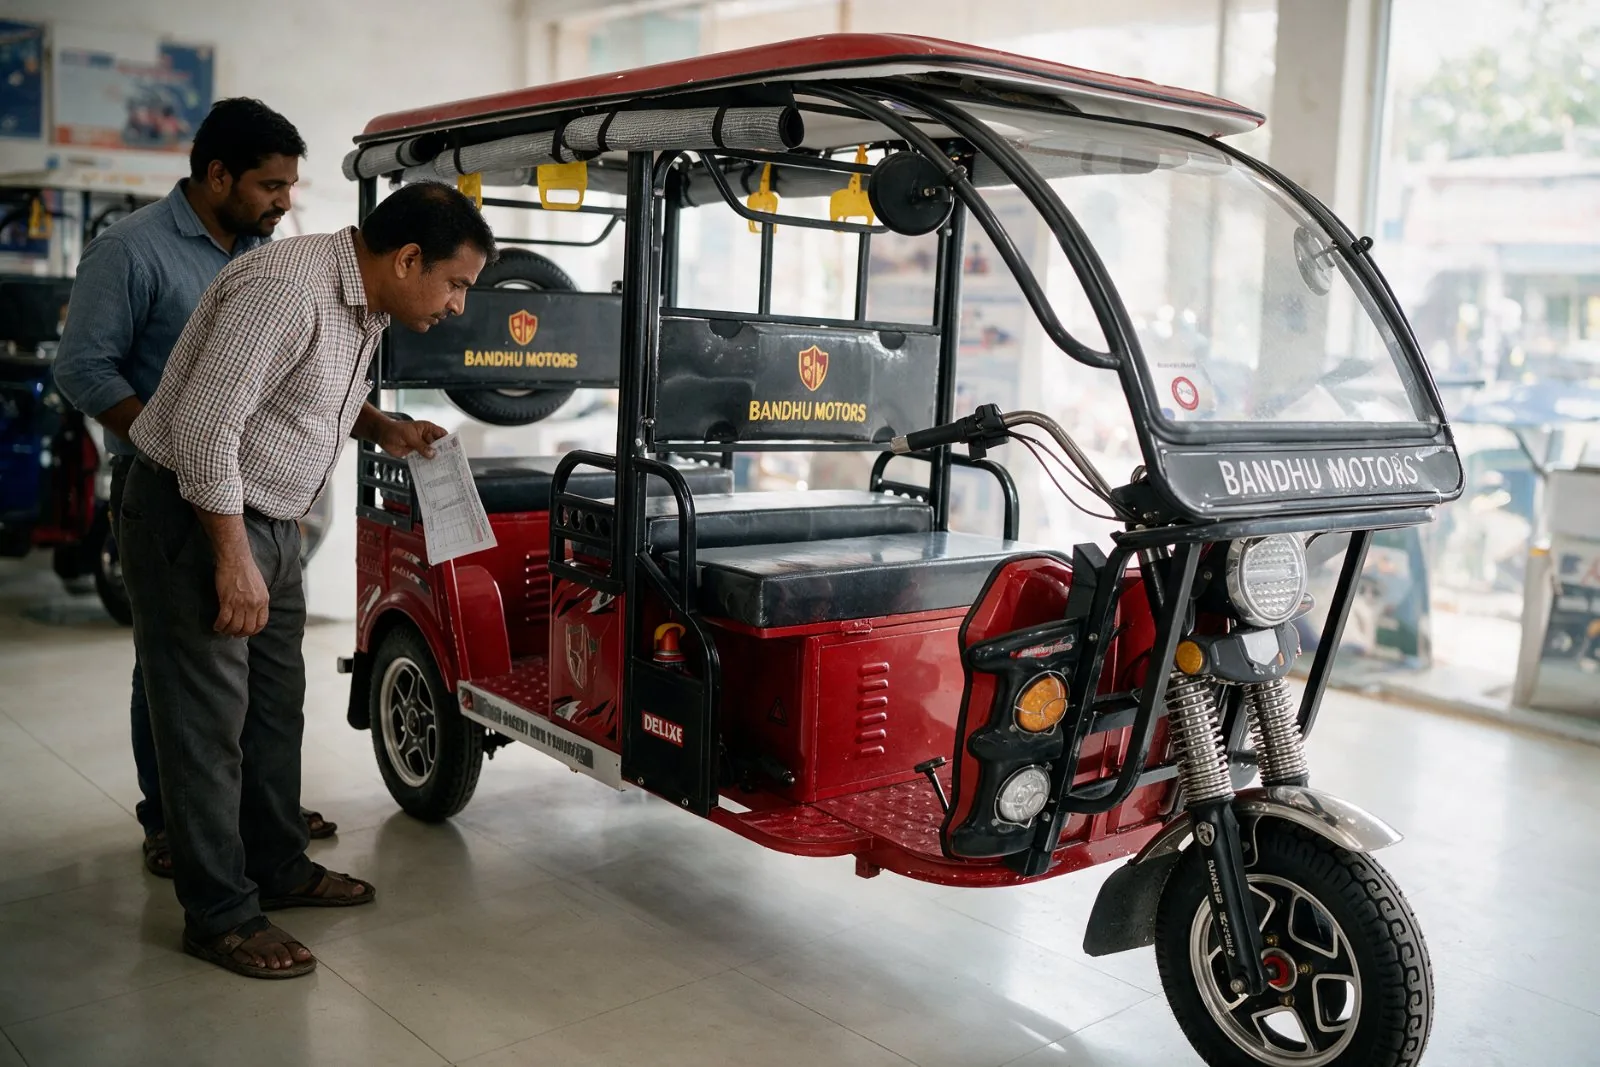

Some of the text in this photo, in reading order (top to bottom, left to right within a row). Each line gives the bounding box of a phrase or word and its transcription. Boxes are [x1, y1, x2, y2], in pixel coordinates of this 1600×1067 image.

[464, 350, 578, 368] BANDHU MOTORS
[749, 400, 866, 423] BANDHU MOTORS
[1218, 454, 1419, 496] BANDHU MOTORS
